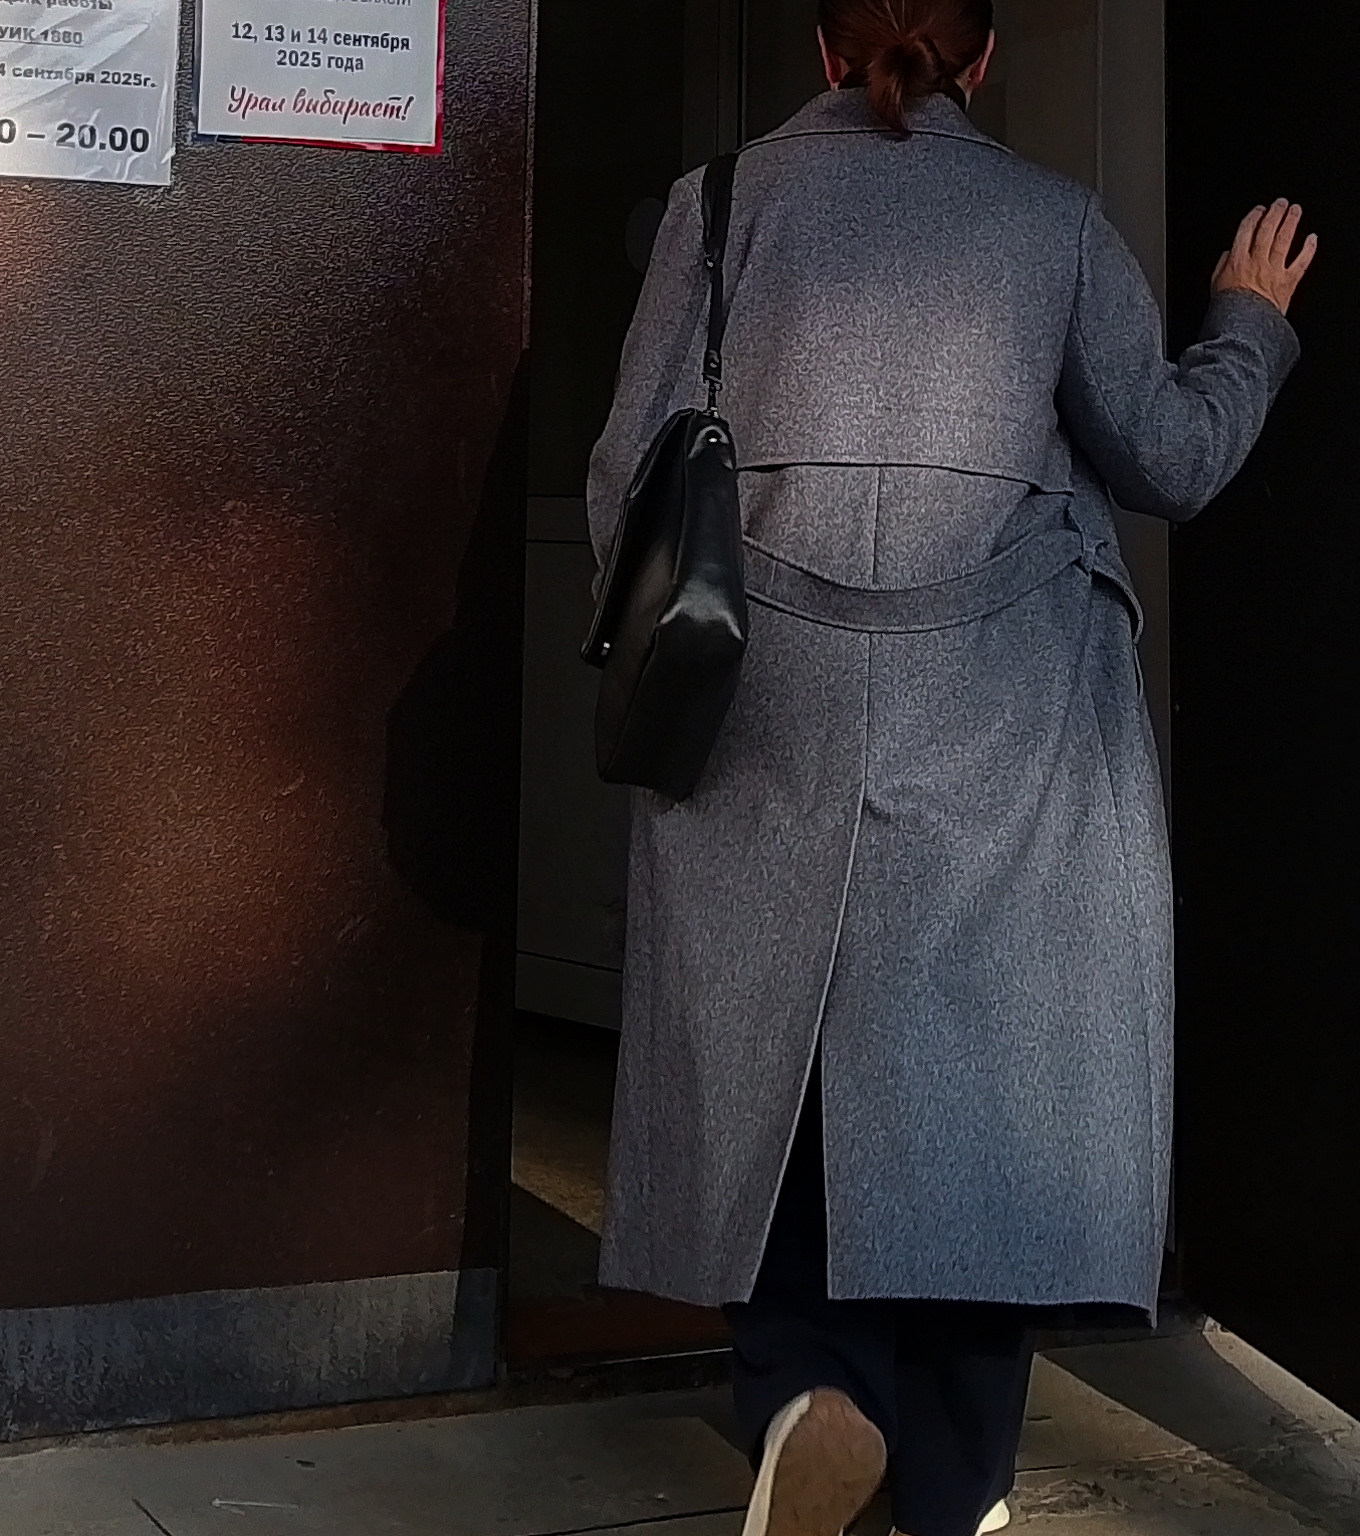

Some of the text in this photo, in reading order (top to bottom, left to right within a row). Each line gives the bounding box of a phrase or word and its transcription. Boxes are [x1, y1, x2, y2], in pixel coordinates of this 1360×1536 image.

[40, 29, 83, 45] 1880
[231, 21, 410, 53] 12, 13 и 14 сентября
[276, 49, 364, 73] 2025 года
[11, 65, 96, 85] сентября
[100, 70, 157, 88] 2025г.
[227, 84, 415, 125] Урал выбирает!
[55, 122, 150, 153] 20.00
